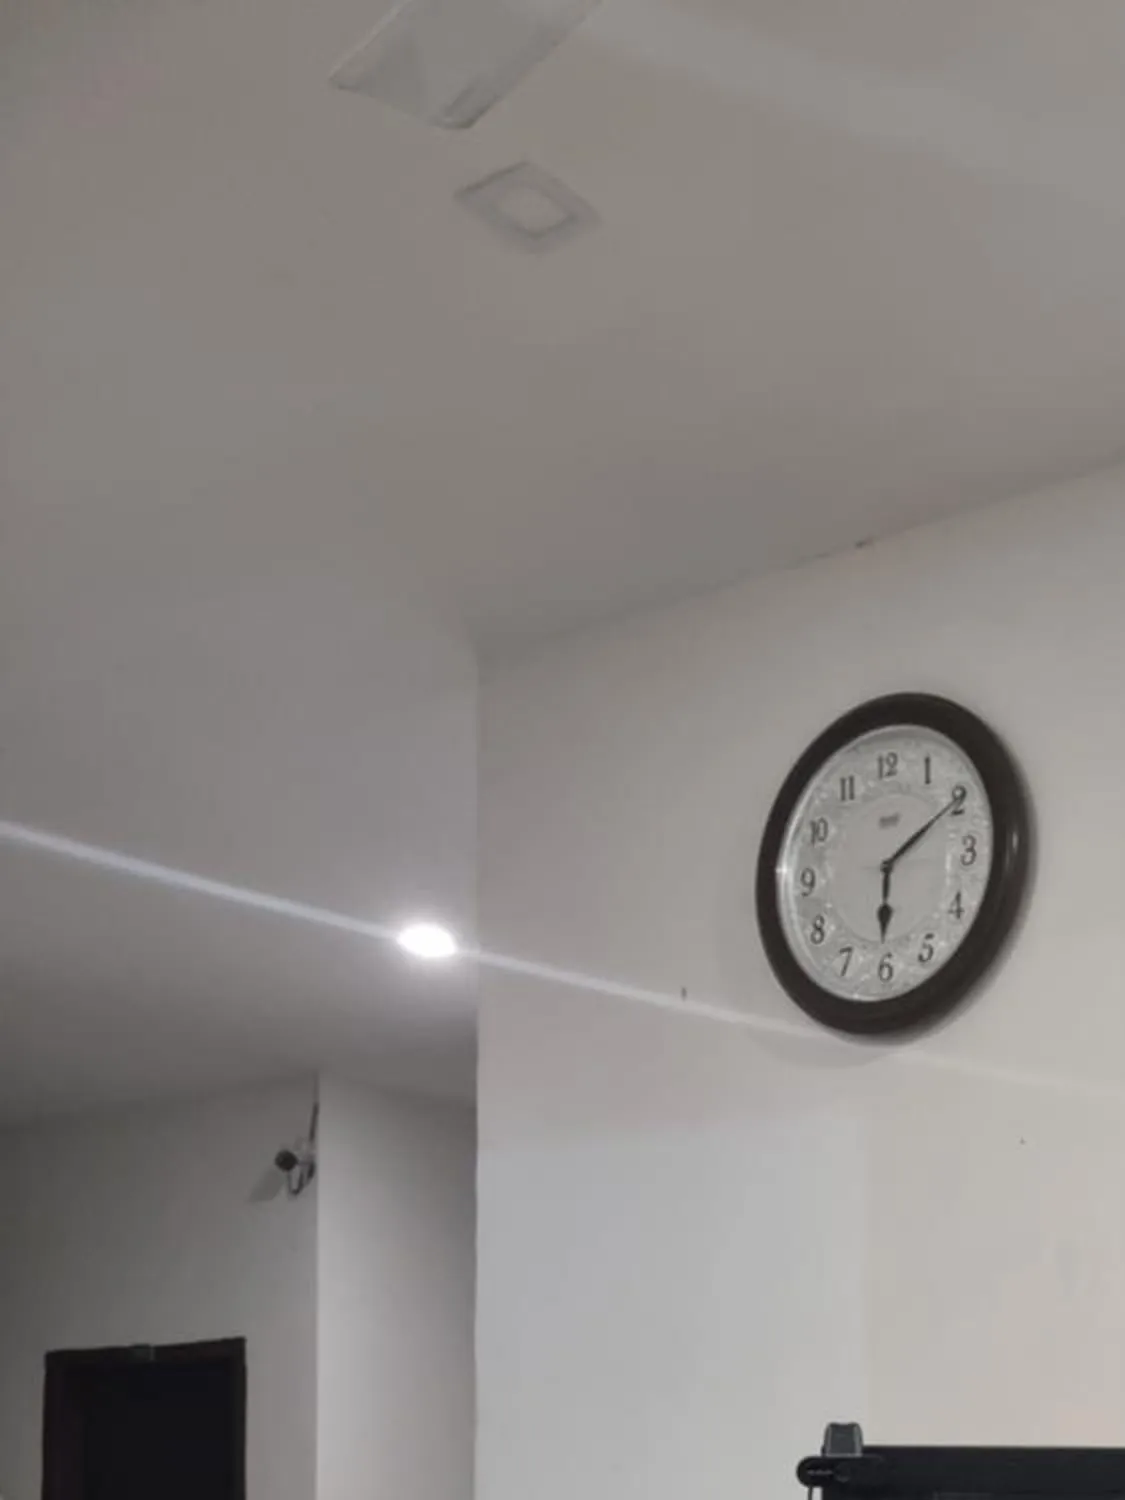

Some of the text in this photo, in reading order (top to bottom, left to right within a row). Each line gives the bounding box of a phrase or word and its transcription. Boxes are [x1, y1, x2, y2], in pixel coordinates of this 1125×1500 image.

[878, 752, 898, 780] 12
[924, 755, 932, 785] 1
[840, 775, 855, 801] 11
[951, 785, 967, 816] 2
[810, 817, 829, 844] 10
[961, 835, 977, 866] 3
[801, 867, 816, 898] 9
[948, 891, 965, 920] 4
[810, 915, 825, 945] 8
[839, 947, 854, 977] 7
[918, 933, 934, 963] 5
[879, 953, 893, 983] 6
